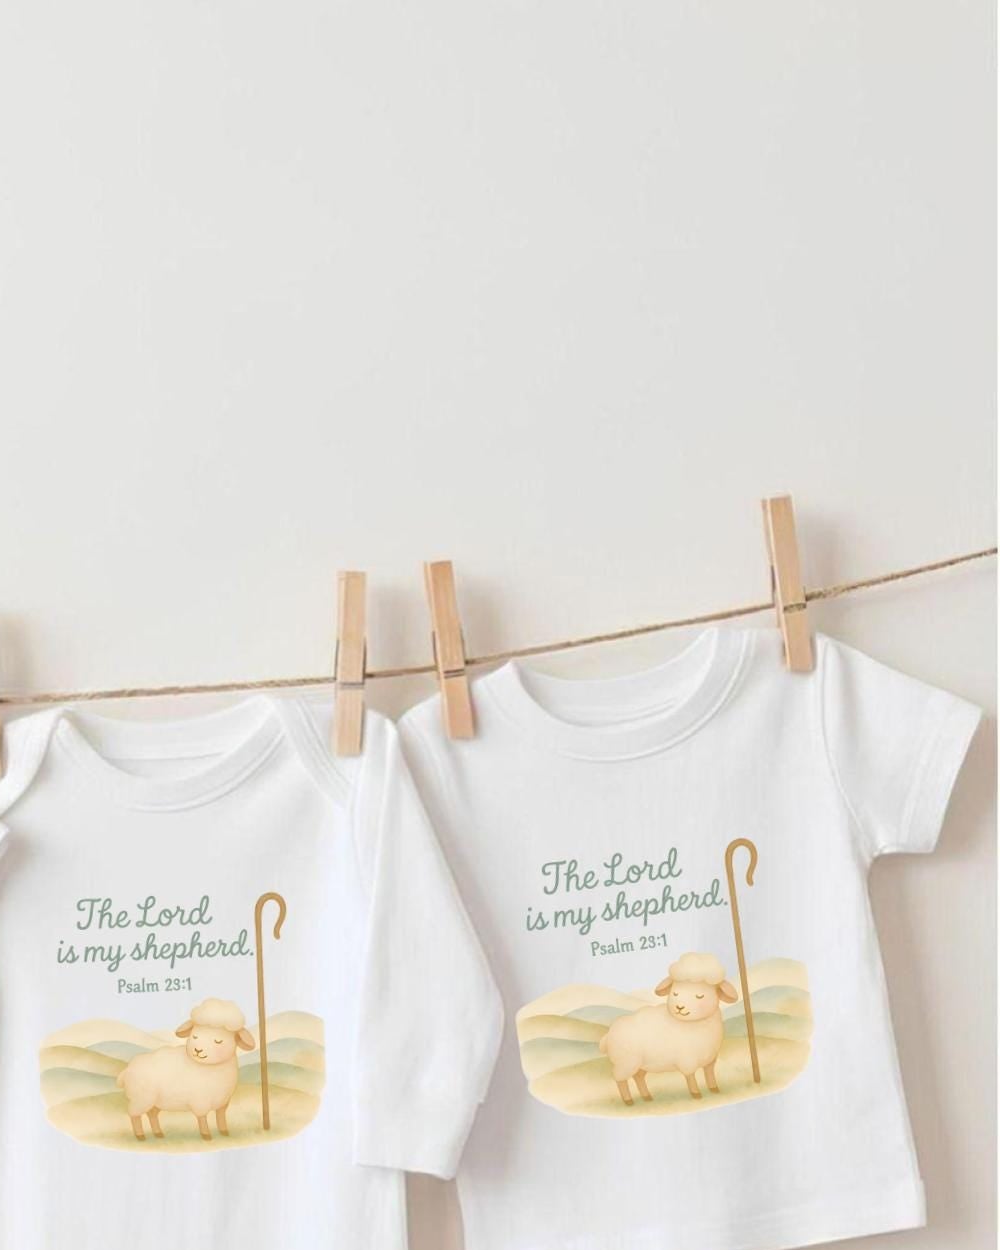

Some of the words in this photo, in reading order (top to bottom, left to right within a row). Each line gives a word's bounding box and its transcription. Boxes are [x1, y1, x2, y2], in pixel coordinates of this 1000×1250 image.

[542, 859, 599, 895] The
[603, 847, 682, 887] Lord
[77, 898, 131, 930] The
[136, 895, 213, 928] Lord
[526, 907, 549, 931] is
[554, 907, 597, 935] my
[601, 879, 728, 926] shepherd.
[57, 941, 79, 963] is
[84, 944, 126, 972] my
[130, 929, 254, 968] shepherd.
[590, 938, 634, 956] Psalm
[639, 934, 667, 950] 23:1
[118, 978, 159, 993] Psalm
[165, 977, 192, 992] 23:1
